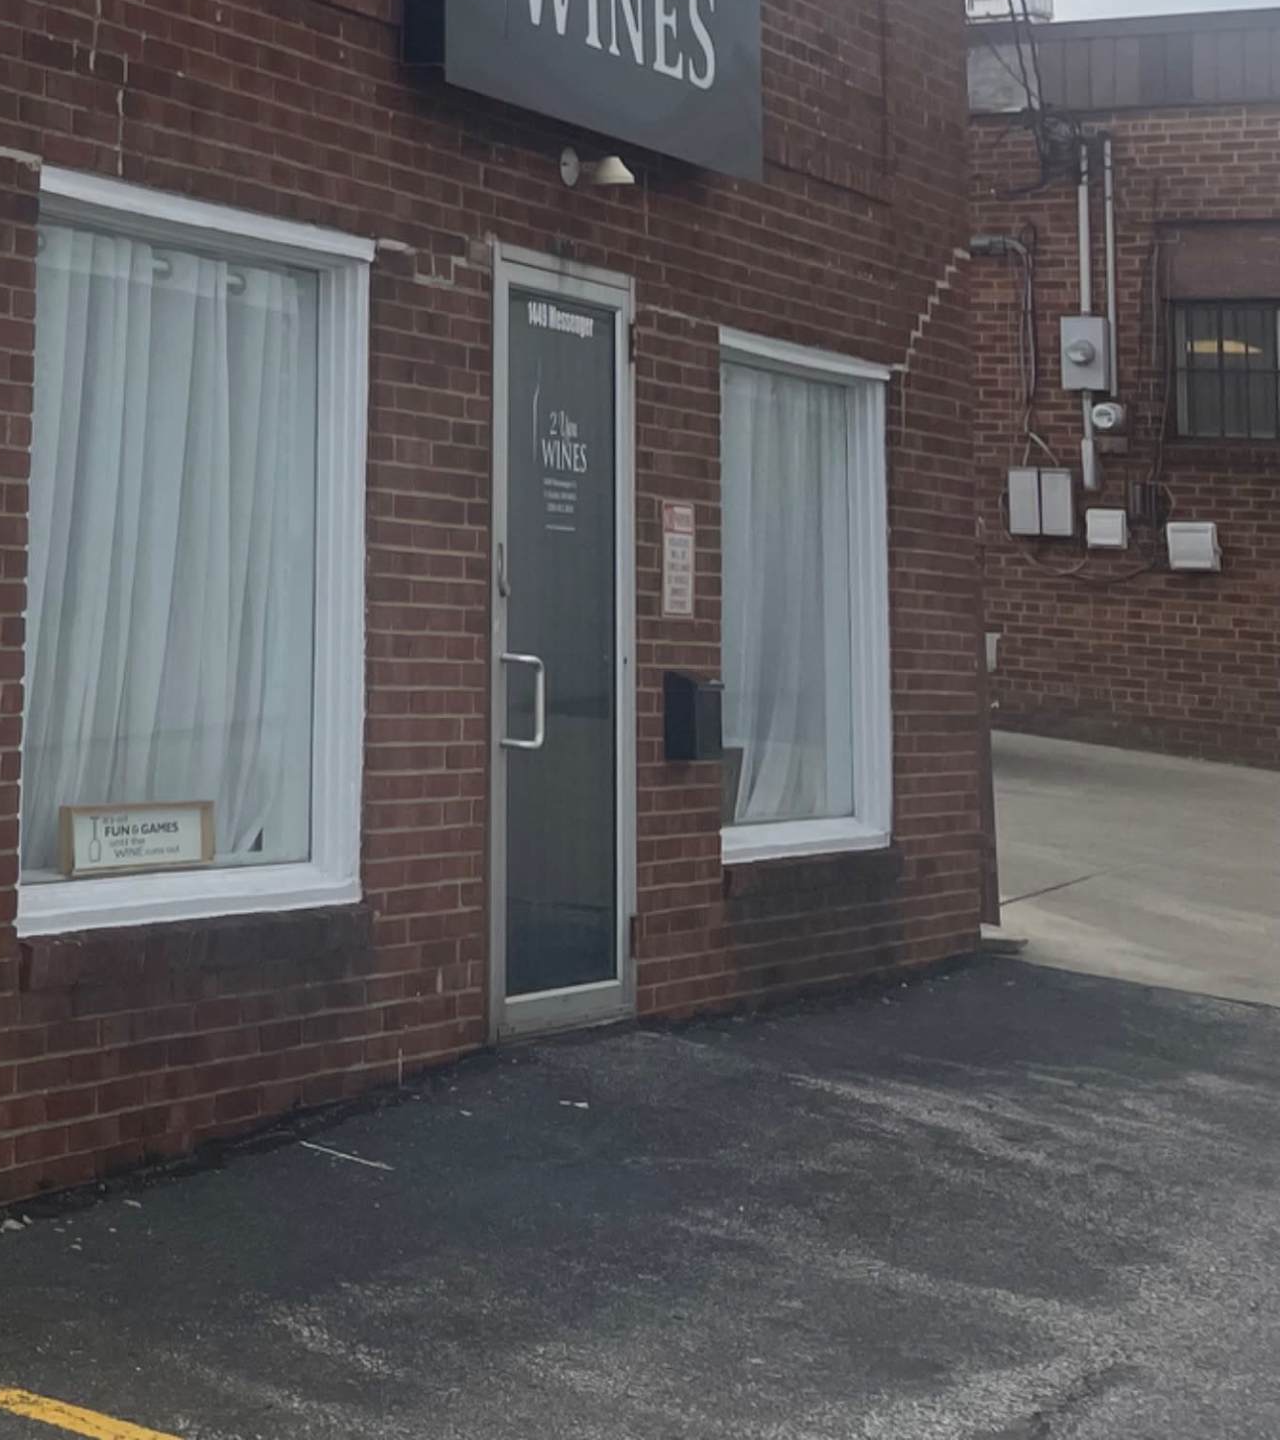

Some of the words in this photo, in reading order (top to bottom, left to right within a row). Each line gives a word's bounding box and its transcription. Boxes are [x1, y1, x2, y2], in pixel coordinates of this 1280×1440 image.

[549, 411, 557, 436] 2
[541, 438, 588, 474] WINES
[104, 823, 130, 838] FUN
[141, 821, 179, 835] GAMES
[113, 846, 143, 859] WINE
